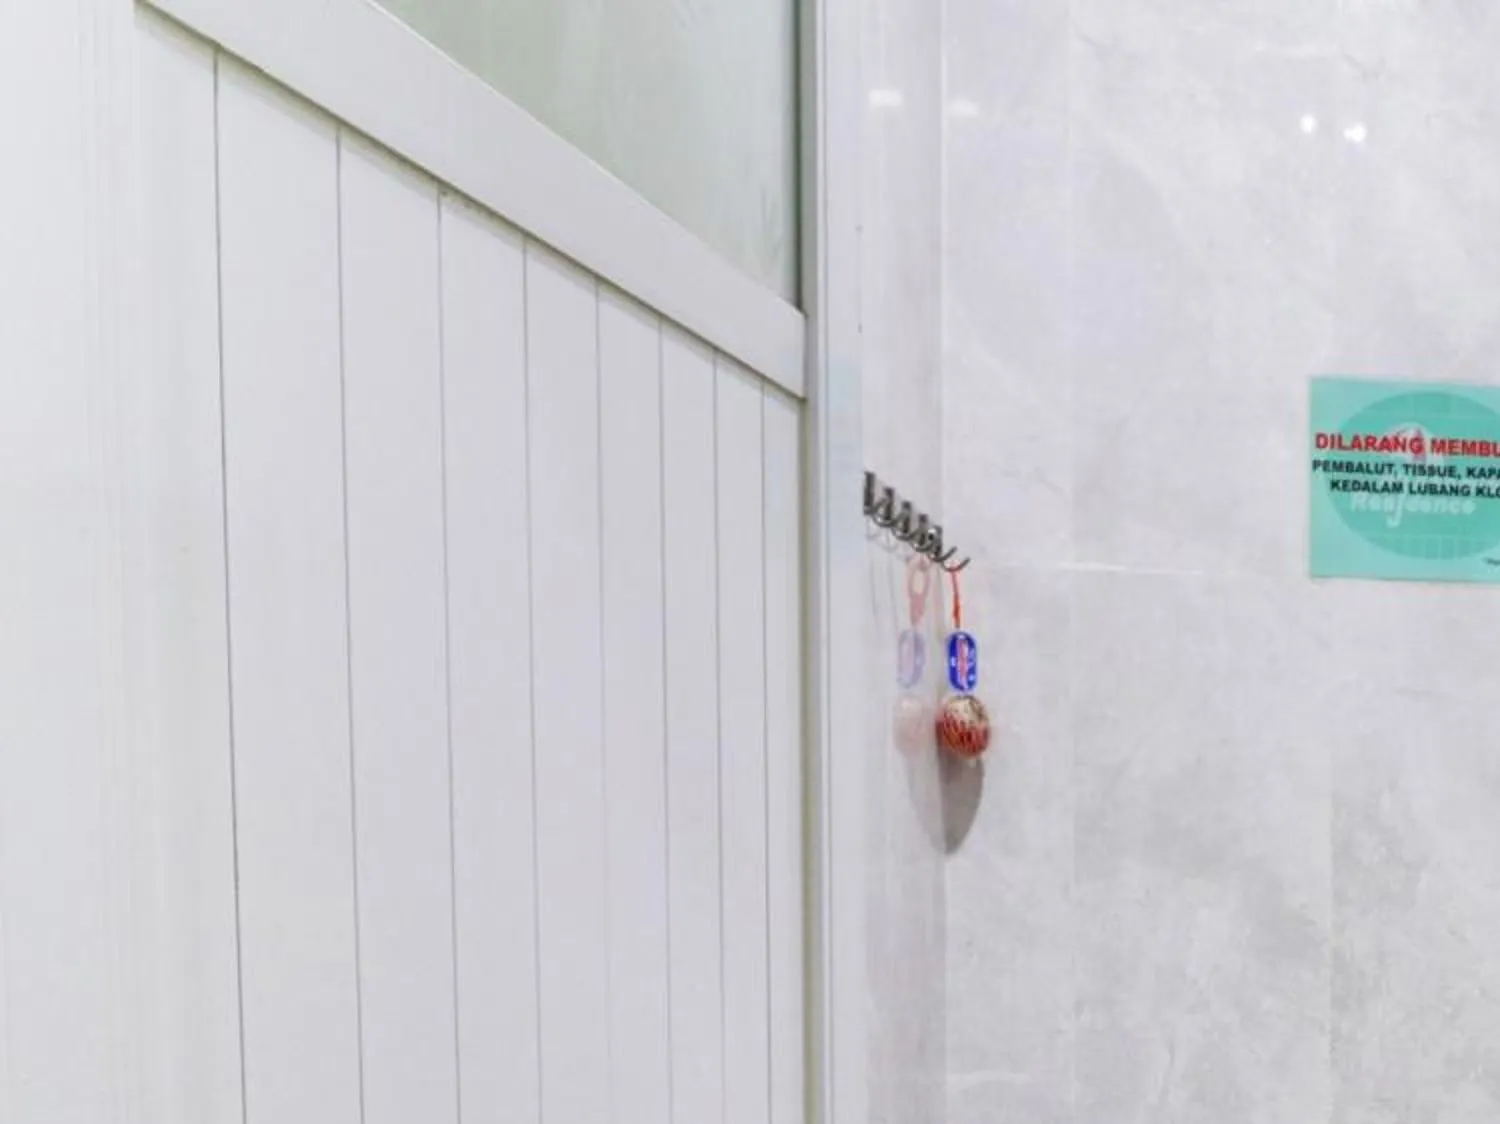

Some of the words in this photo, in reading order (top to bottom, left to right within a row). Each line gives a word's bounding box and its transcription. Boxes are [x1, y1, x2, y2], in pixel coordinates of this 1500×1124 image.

[1315, 432, 1425, 455] DILARANG
[1312, 459, 1398, 477] PEMBALUT,
[1402, 463, 1462, 480] TISSUE,
[1330, 479, 1404, 494] KEDALAM
[1408, 482, 1471, 497] LUBANG
